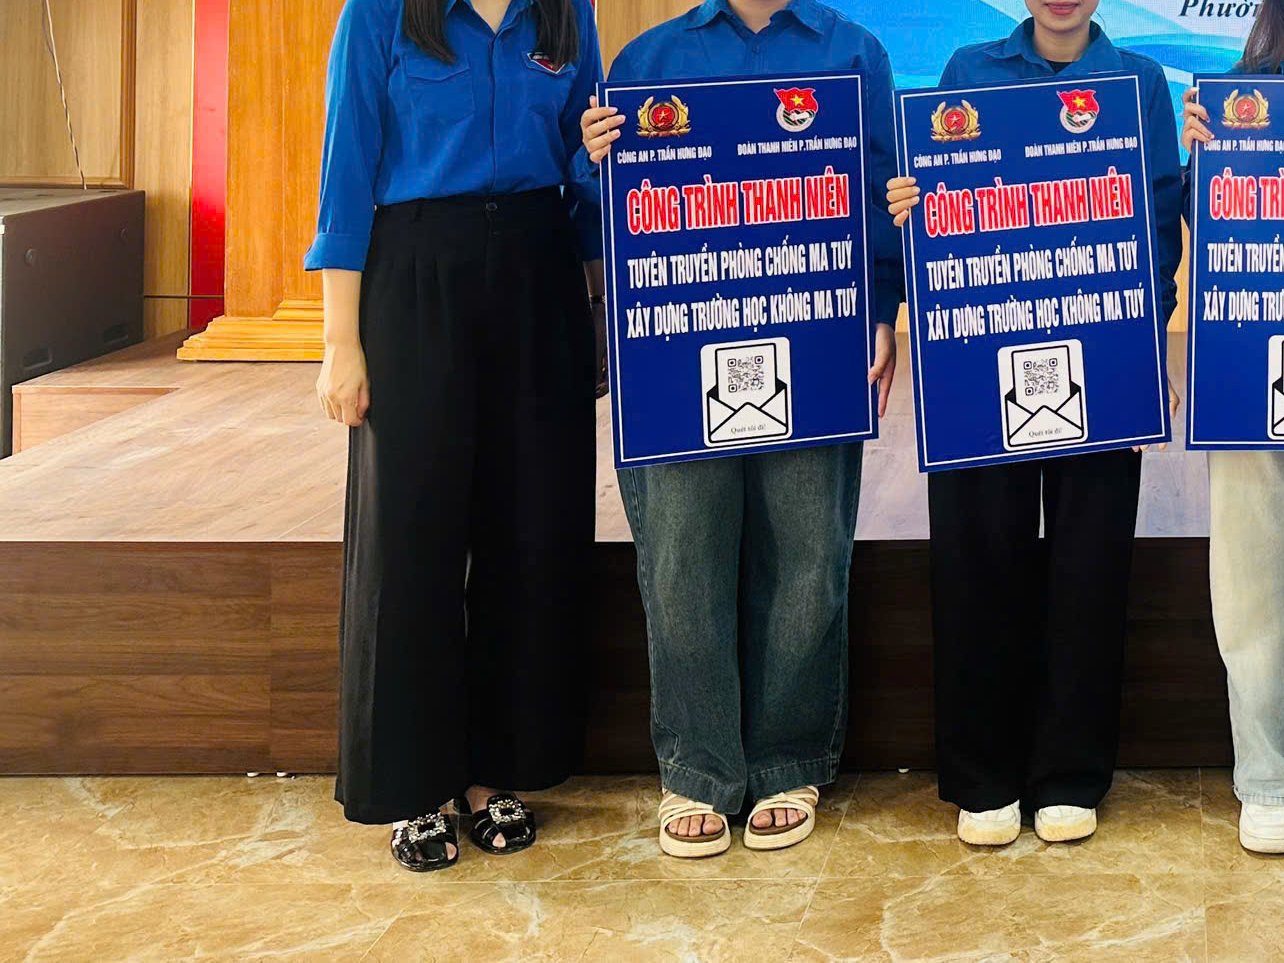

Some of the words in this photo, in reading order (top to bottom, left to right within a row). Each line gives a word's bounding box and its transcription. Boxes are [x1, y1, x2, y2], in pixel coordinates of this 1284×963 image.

[626, 178, 680, 235] CÔNG
[683, 174, 739, 230] TRÌNH
[740, 176, 803, 224] THANH
[804, 165, 849, 219] NIÊN
[924, 182, 975, 237] CÔNG
[975, 177, 1030, 232] TRÌNH
[1030, 178, 1089, 226] THANH
[1089, 166, 1133, 220] NIÊN
[1210, 167, 1257, 220] CÔNG
[627, 250, 667, 289] TUYÊN
[670, 243, 718, 285] TRUYỀN
[721, 242, 762, 280] PHÒNG
[765, 235, 806, 276] CHỐNG
[809, 242, 829, 272] MA
[831, 234, 853, 270] TUÝ
[926, 253, 964, 291] TUYÊN
[966, 244, 1011, 287] TRUYỀN
[1013, 244, 1053, 282] PHÒNG
[1055, 236, 1095, 277] CHỐNG
[1096, 243, 1116, 273] MA
[1117, 234, 1138, 271] TUÝ
[1207, 237, 1242, 272] TUYÊN
[626, 301, 650, 338] XÂY
[654, 301, 688, 341] DỰNG
[691, 293, 740, 331] TRƯỜNG
[742, 296, 767, 332] HỌC
[770, 287, 811, 324] KHÔNG
[814, 290, 834, 319] MA
[836, 281, 857, 317] TUÝ
[926, 304, 949, 341] XÂY
[952, 304, 985, 343] DỰNG
[987, 295, 1034, 334] TRƯỜNG
[1035, 297, 1059, 334] HỌC
[1061, 288, 1101, 326] KHÔNG
[1103, 291, 1123, 321] MA
[1124, 282, 1145, 319] TUÝ
[1203, 285, 1226, 321] XÂY
[1228, 289, 1259, 328] DỰNG
